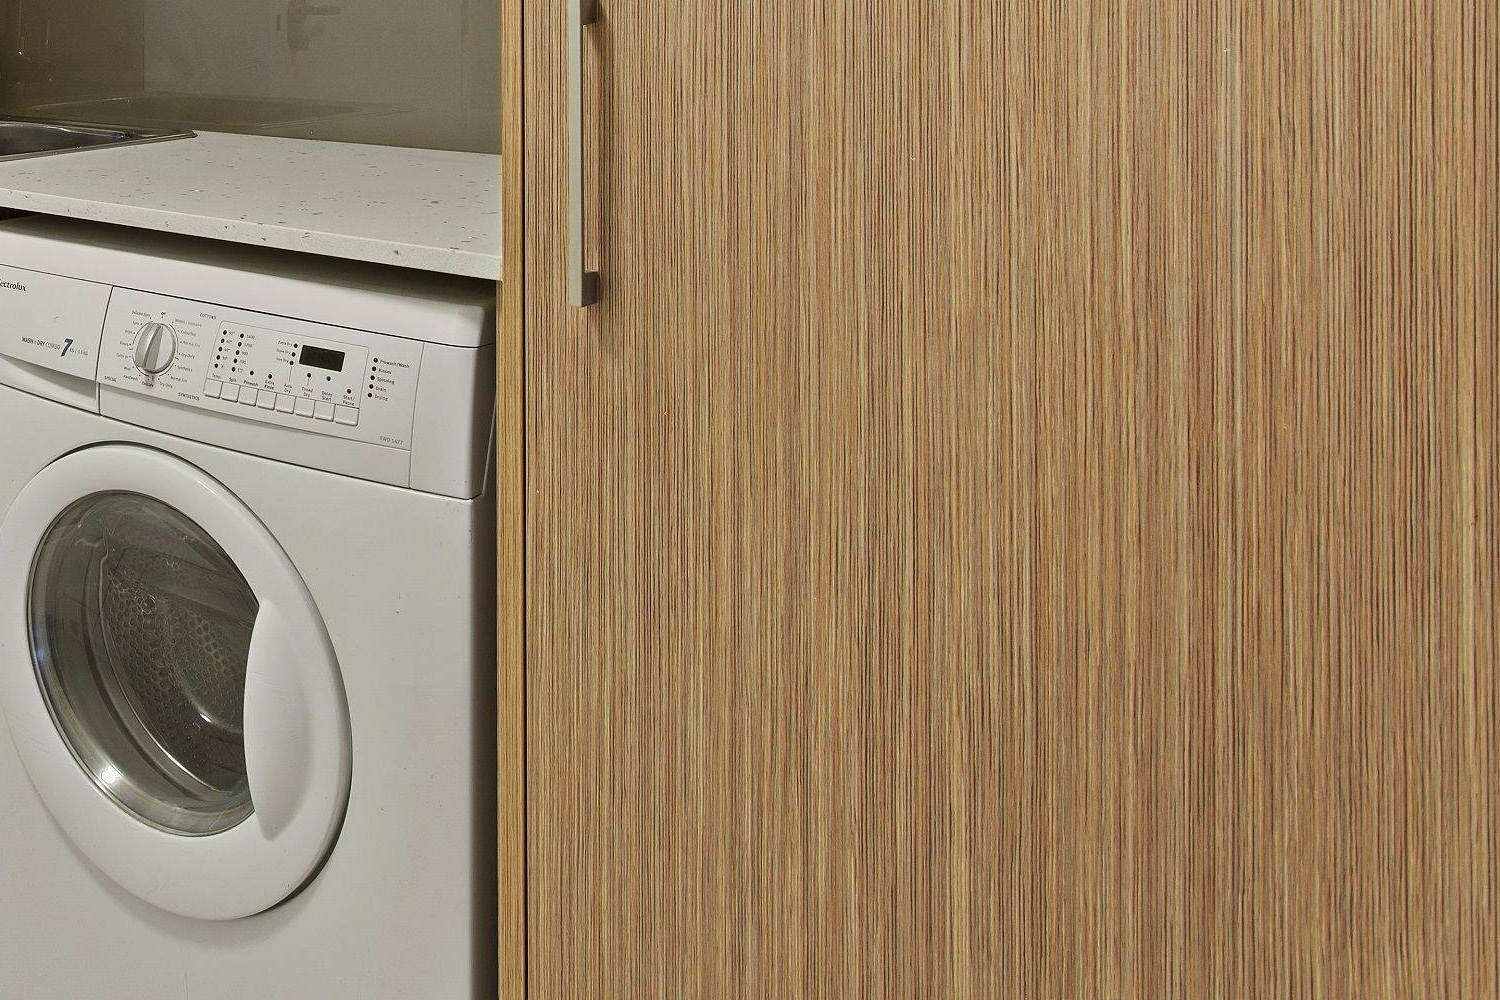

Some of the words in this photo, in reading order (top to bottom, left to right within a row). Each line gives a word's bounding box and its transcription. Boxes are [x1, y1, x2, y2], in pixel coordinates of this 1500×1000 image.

[200, 312, 217, 320] COTTONS
[45, 341, 60, 350] COMBO
[61, 338, 74, 357] 7
[377, 377, 395, 385] Spinning
[178, 392, 200, 401] SYNTHETICS
[374, 394, 389, 402] Drying
